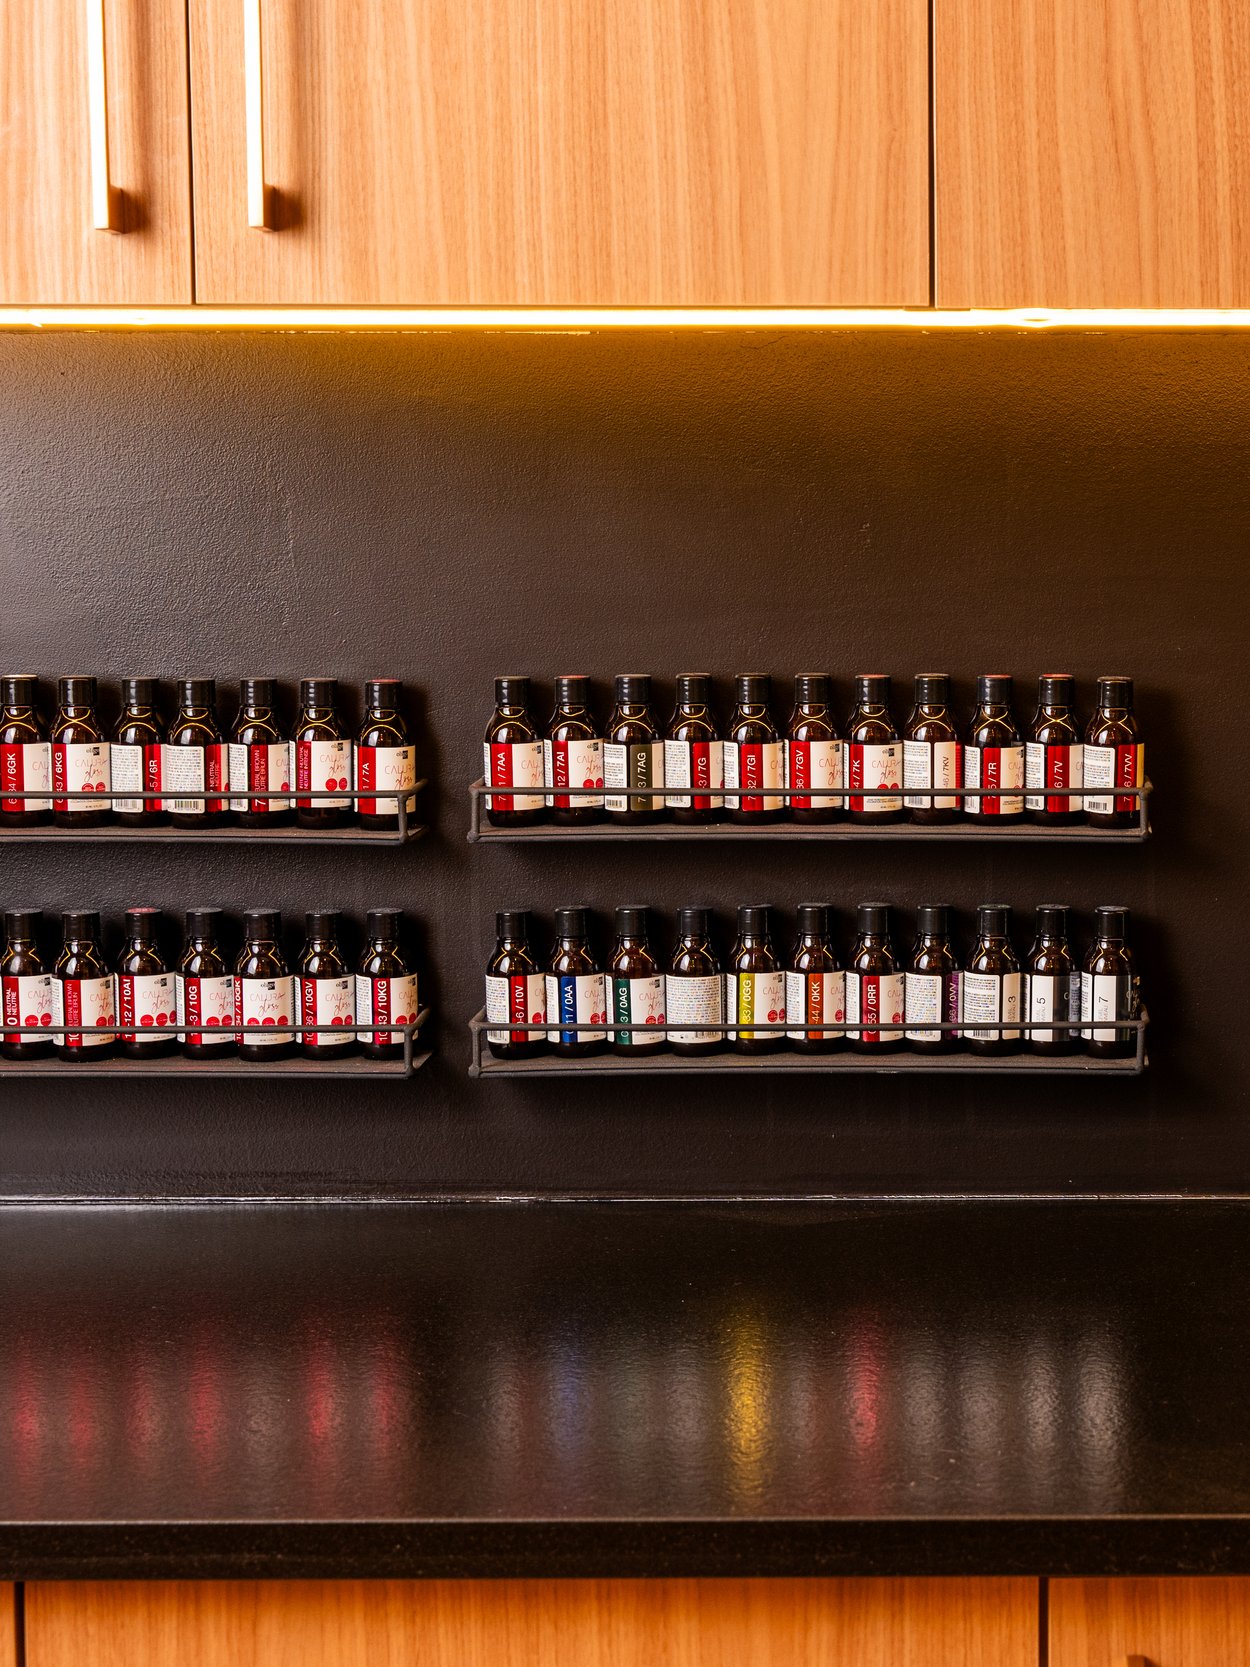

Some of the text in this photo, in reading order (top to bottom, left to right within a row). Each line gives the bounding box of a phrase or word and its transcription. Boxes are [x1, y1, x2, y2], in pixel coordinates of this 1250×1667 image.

[8, 753, 17, 774] 6GK
[56, 752, 64, 772] 6KG
[150, 760, 158, 773] 6R
[498, 752, 506, 771] 7AA
[557, 752, 565, 766] 7AI
[638, 752, 646, 773] 7AG
[699, 757, 707, 770] 7G
[748, 755, 756, 770] 7GI
[796, 750, 804, 770] 7GV
[853, 760, 860, 772] 7K
[988, 762, 996, 775] 7R
[1054, 760, 1063, 773] 7V
[362, 763, 369, 776] 7A
[124, 979, 132, 1000] 10AI
[190, 986, 198, 1005] 10G
[306, 982, 314, 1006] 10GV
[378, 981, 387, 1006] 10KG
[516, 986, 524, 1003] 10V
[565, 985, 573, 1004] 0AA
[620, 988, 628, 1007] 0AG
[743, 979, 751, 1000] 0GG
[812, 982, 820, 1000] 0KK
[868, 984, 876, 1004] 0RR
